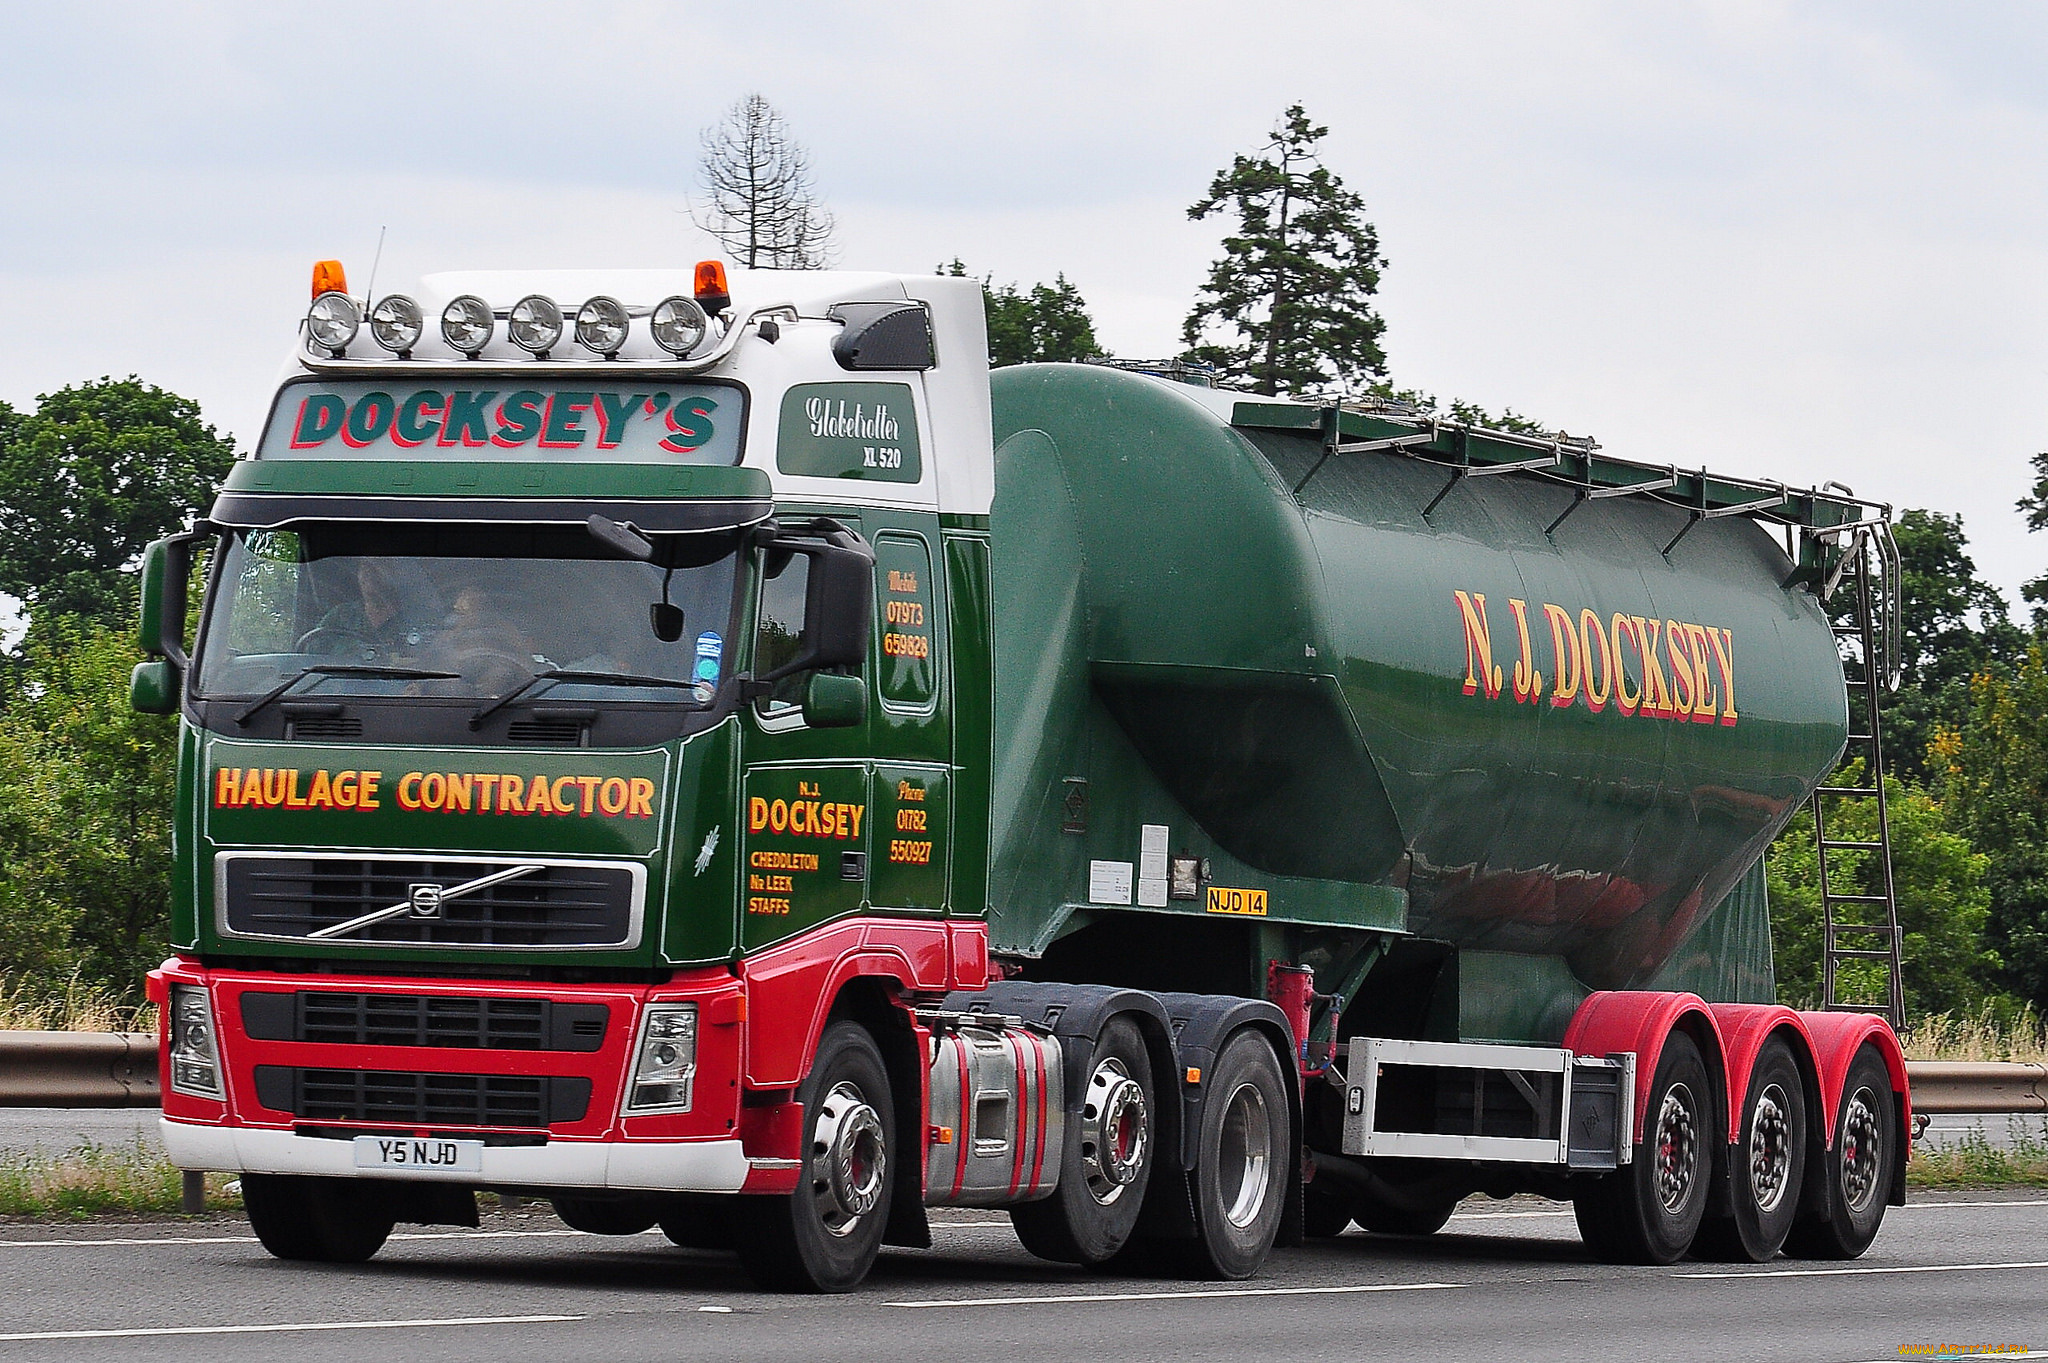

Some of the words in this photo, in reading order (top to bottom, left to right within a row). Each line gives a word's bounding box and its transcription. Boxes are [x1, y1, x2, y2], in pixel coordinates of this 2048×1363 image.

[289, 390, 719, 454] DOCKSEY'S
[805, 397, 899, 440] Globetrotter
[863, 446, 877, 467] XL
[880, 447, 902, 469] 520
[886, 601, 924, 626] 07973
[1454, 590, 1502, 700] N.
[1509, 598, 1542, 705] J.
[1543, 603, 1738, 727] DOCKSEY
[215, 767, 382, 810] HAULAGE
[397, 772, 656, 818] CONTRACTOR
[898, 780, 926, 801] Phone
[749, 796, 865, 841] DOCKSEY
[897, 809, 927, 832] 01782
[751, 851, 819, 871] CHEDDLETON
[890, 839, 932, 864] 550927
[766, 875, 793, 893] LEEK
[749, 897, 790, 916] STAFFS
[1209, 889, 1242, 912] NJD
[1248, 893, 1263, 914] 14
[379, 1140, 406, 1162] Y5
[414, 1142, 456, 1165] NJD
